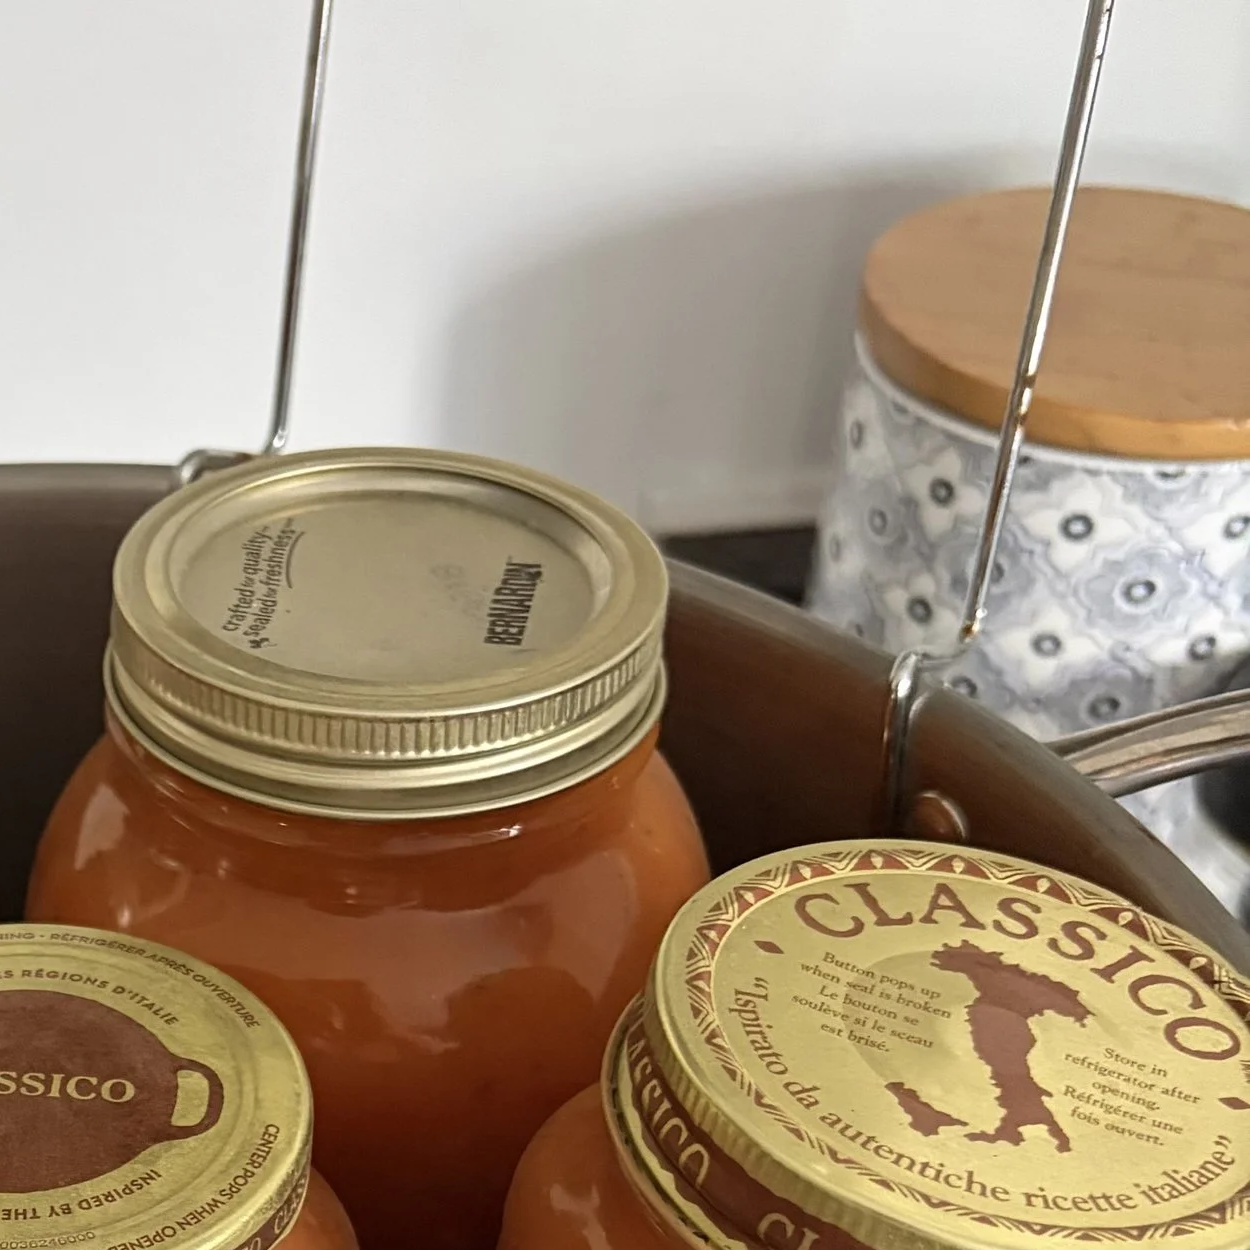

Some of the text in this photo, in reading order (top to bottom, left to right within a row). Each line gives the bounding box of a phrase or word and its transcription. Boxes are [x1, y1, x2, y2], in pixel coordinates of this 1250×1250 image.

[221, 588, 255, 632] crafted
[243, 598, 278, 637] sealed
[483, 562, 542, 646] BERNARDIN
[794, 882, 1241, 1061] CLASSICO
[800, 962, 951, 1019] when seal is broken
[822, 952, 941, 1000] Button pops up
[21, 968, 110, 990] RÉGIONS
[112, 985, 180, 1026] D'ITALIE
[192, 973, 261, 1028] OUVERTURE
[819, 985, 920, 1026] Le bouton se
[791, 995, 934, 1049] soulève si le sceau
[820, 1023, 891, 1052] est brisé.
[1064, 1052, 1201, 1104] refrigerator after
[1103, 1048, 1168, 1078] Store in
[1062, 1085, 1184, 1135] Réfrigérer une
[1071, 1106, 1165, 1146] fois ouvert.
[249, 1123, 280, 1168] CENTER
[783, 1079, 821, 1111] da
[818, 1111, 1011, 1202] autentiche
[1022, 1186, 1138, 1212] ricette
[78, 1168, 162, 1211] INSPIRED
[225, 1167, 254, 1201] POPS
[2, 1208, 41, 1221] THE
[48, 1205, 72, 1218] BY
[180, 1189, 227, 1231] WHEN
